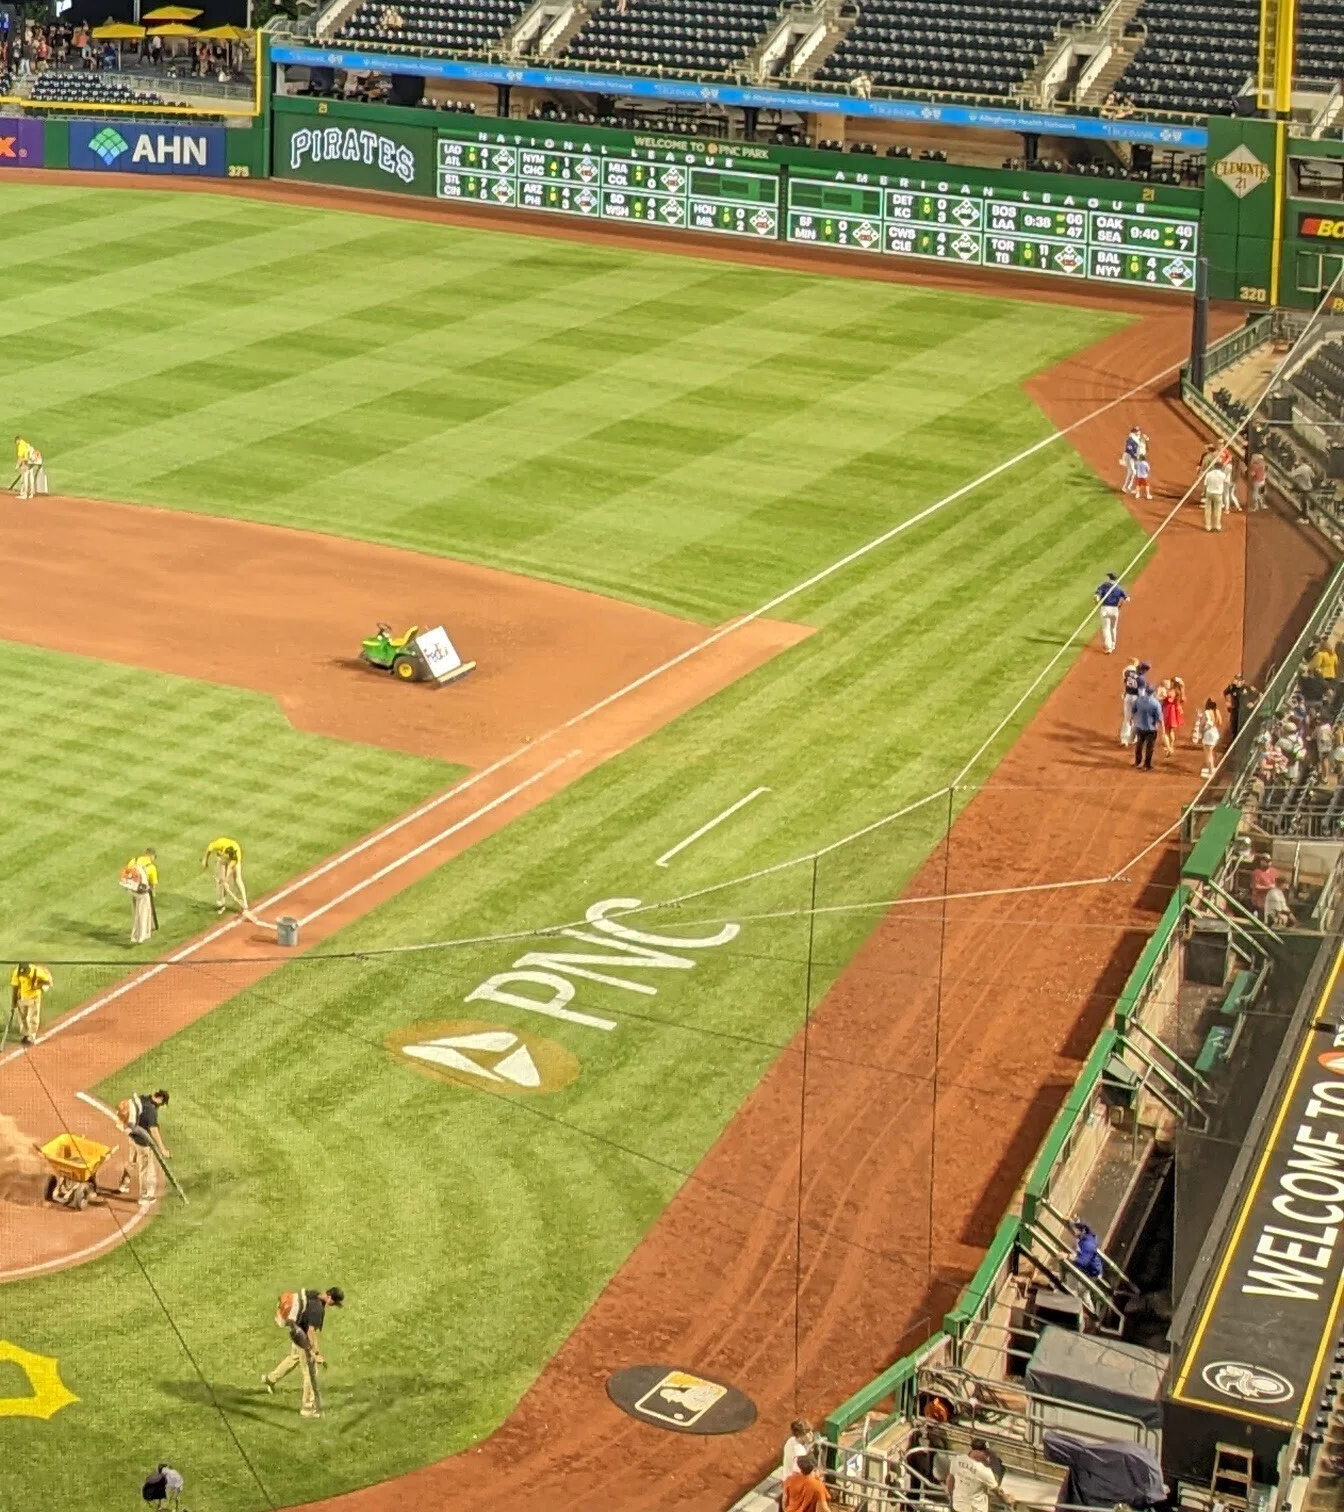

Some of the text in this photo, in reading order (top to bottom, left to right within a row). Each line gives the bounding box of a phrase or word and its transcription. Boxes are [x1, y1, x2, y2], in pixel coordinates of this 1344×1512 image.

[132, 133, 207, 166] AHN
[478, 132, 608, 155] NATIONAL
[634, 136, 769, 160] WELCOME TO PNC PARK
[290, 126, 415, 184] PIRATES
[444, 156, 461, 167] ATL
[523, 152, 545, 164] NYM
[630, 148, 733, 168] LEAGUE
[523, 165, 545, 176] CHC
[609, 162, 628, 175] MIA
[1213, 159, 1269, 183] CLEMENTE
[444, 174, 487, 187] STL 7
[608, 174, 656, 189] COL 0
[835, 170, 994, 197] AMERICAN
[1235, 176, 1247, 189] 21
[647, 198, 656, 208] 4
[892, 193, 947, 210] DET 0
[1022, 190, 1145, 214] LEAGUE
[606, 204, 629, 217] WSH
[693, 203, 745, 219] HOU 0
[894, 206, 946, 222] KC 3
[992, 204, 1017, 217] BOS
[736, 221, 744, 231] 2
[838, 220, 847, 231] 0
[992, 217, 1083, 238] LAA 47
[1096, 216, 1160, 240] OAK 9:40
[795, 227, 847, 244] MIN 2
[888, 226, 946, 243] CWS 4
[1097, 229, 1188, 250] SEA 7
[891, 239, 945, 256] CLE 2
[991, 238, 1049, 255] TOR 11
[995, 251, 1047, 268] TB 1
[1097, 251, 1156, 268] BAL 4
[1095, 264, 1156, 282] NYY 4
[1240, 286, 1266, 302] 320
[463, 897, 741, 1030] PNC
[1241, 1124, 1344, 1301] WELCOME
